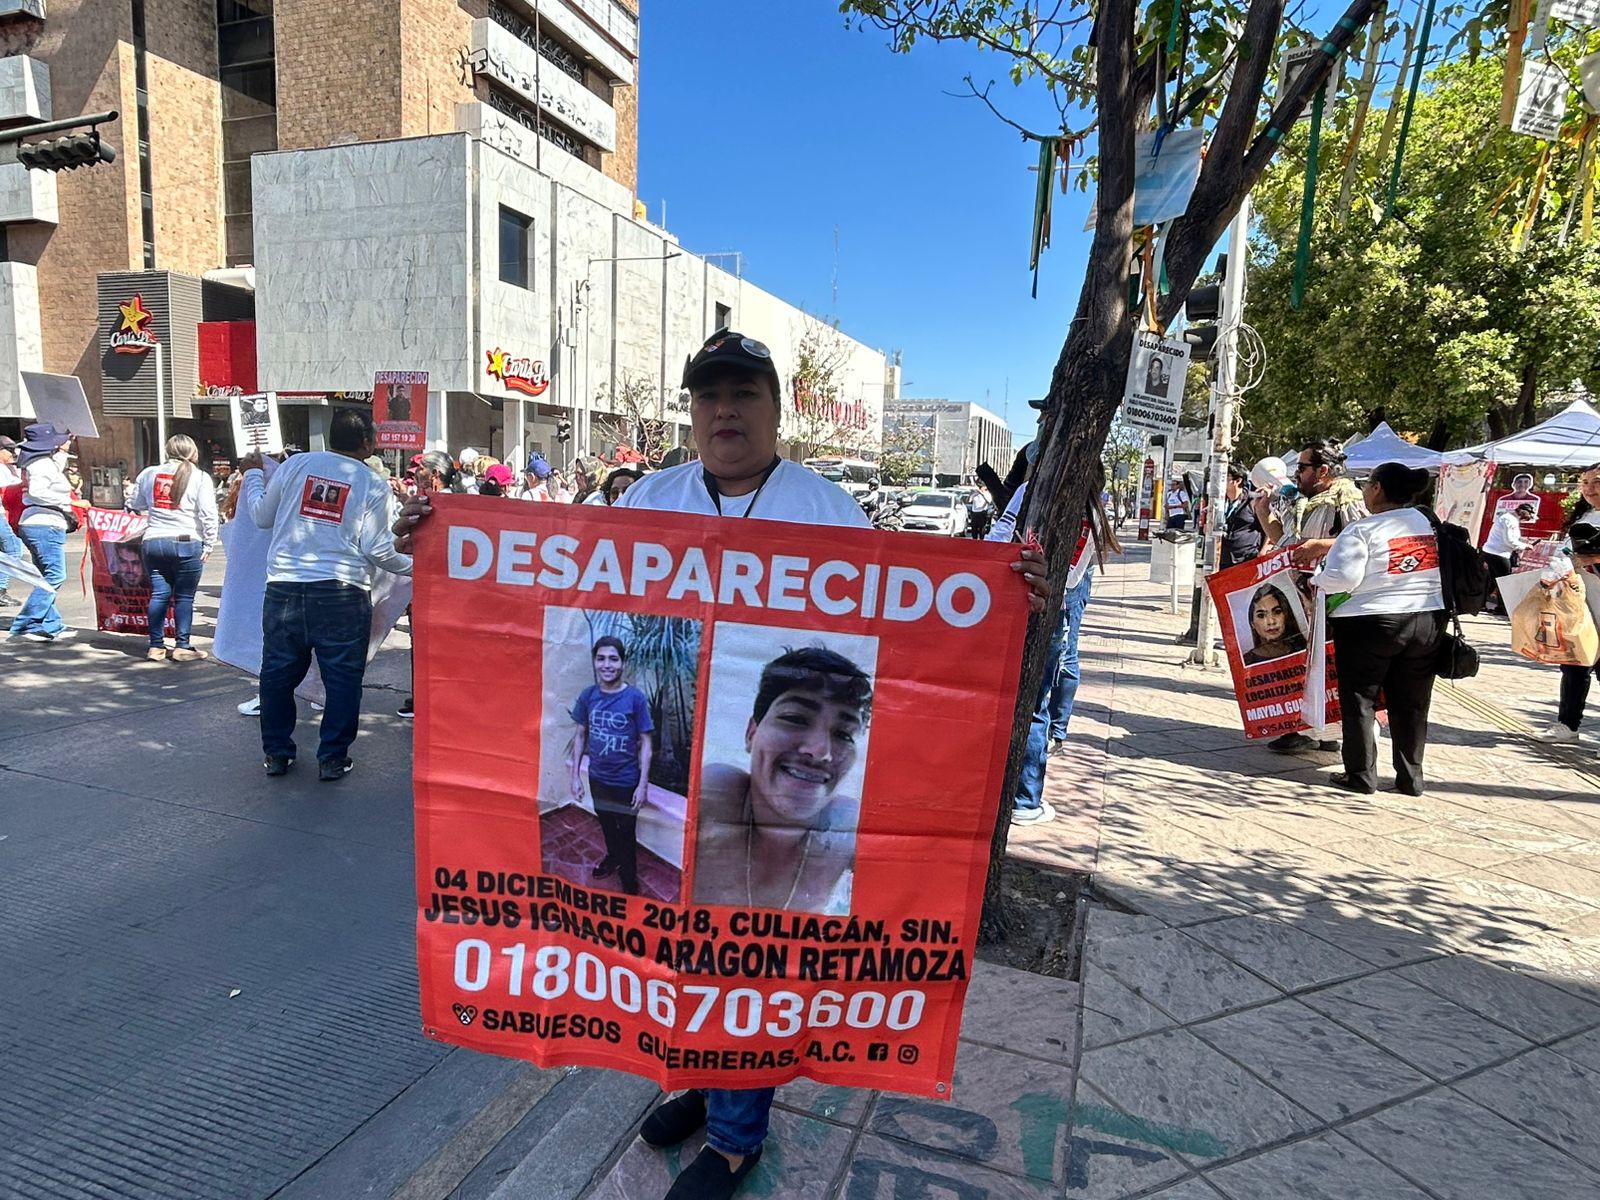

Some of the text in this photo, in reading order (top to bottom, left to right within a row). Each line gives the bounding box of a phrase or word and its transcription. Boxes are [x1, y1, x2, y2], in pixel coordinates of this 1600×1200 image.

[376, 371, 428, 384] DESAPARECIDO
[1139, 339, 1185, 358] DESAPARECIDO
[446, 524, 991, 629] DESAPARECIDO
[1246, 704, 1285, 721] MAYRA
[424, 893, 967, 982] JESUS IGNACIO ARAGON RETAMOZA
[434, 866, 960, 946] 04 DICIEMBRE 2018, CULIACÁN, SIN.
[453, 938, 927, 1038] 018006703600
[482, 1009, 622, 1044] SABUESOS
[804, 1040, 856, 1062] A.C.
